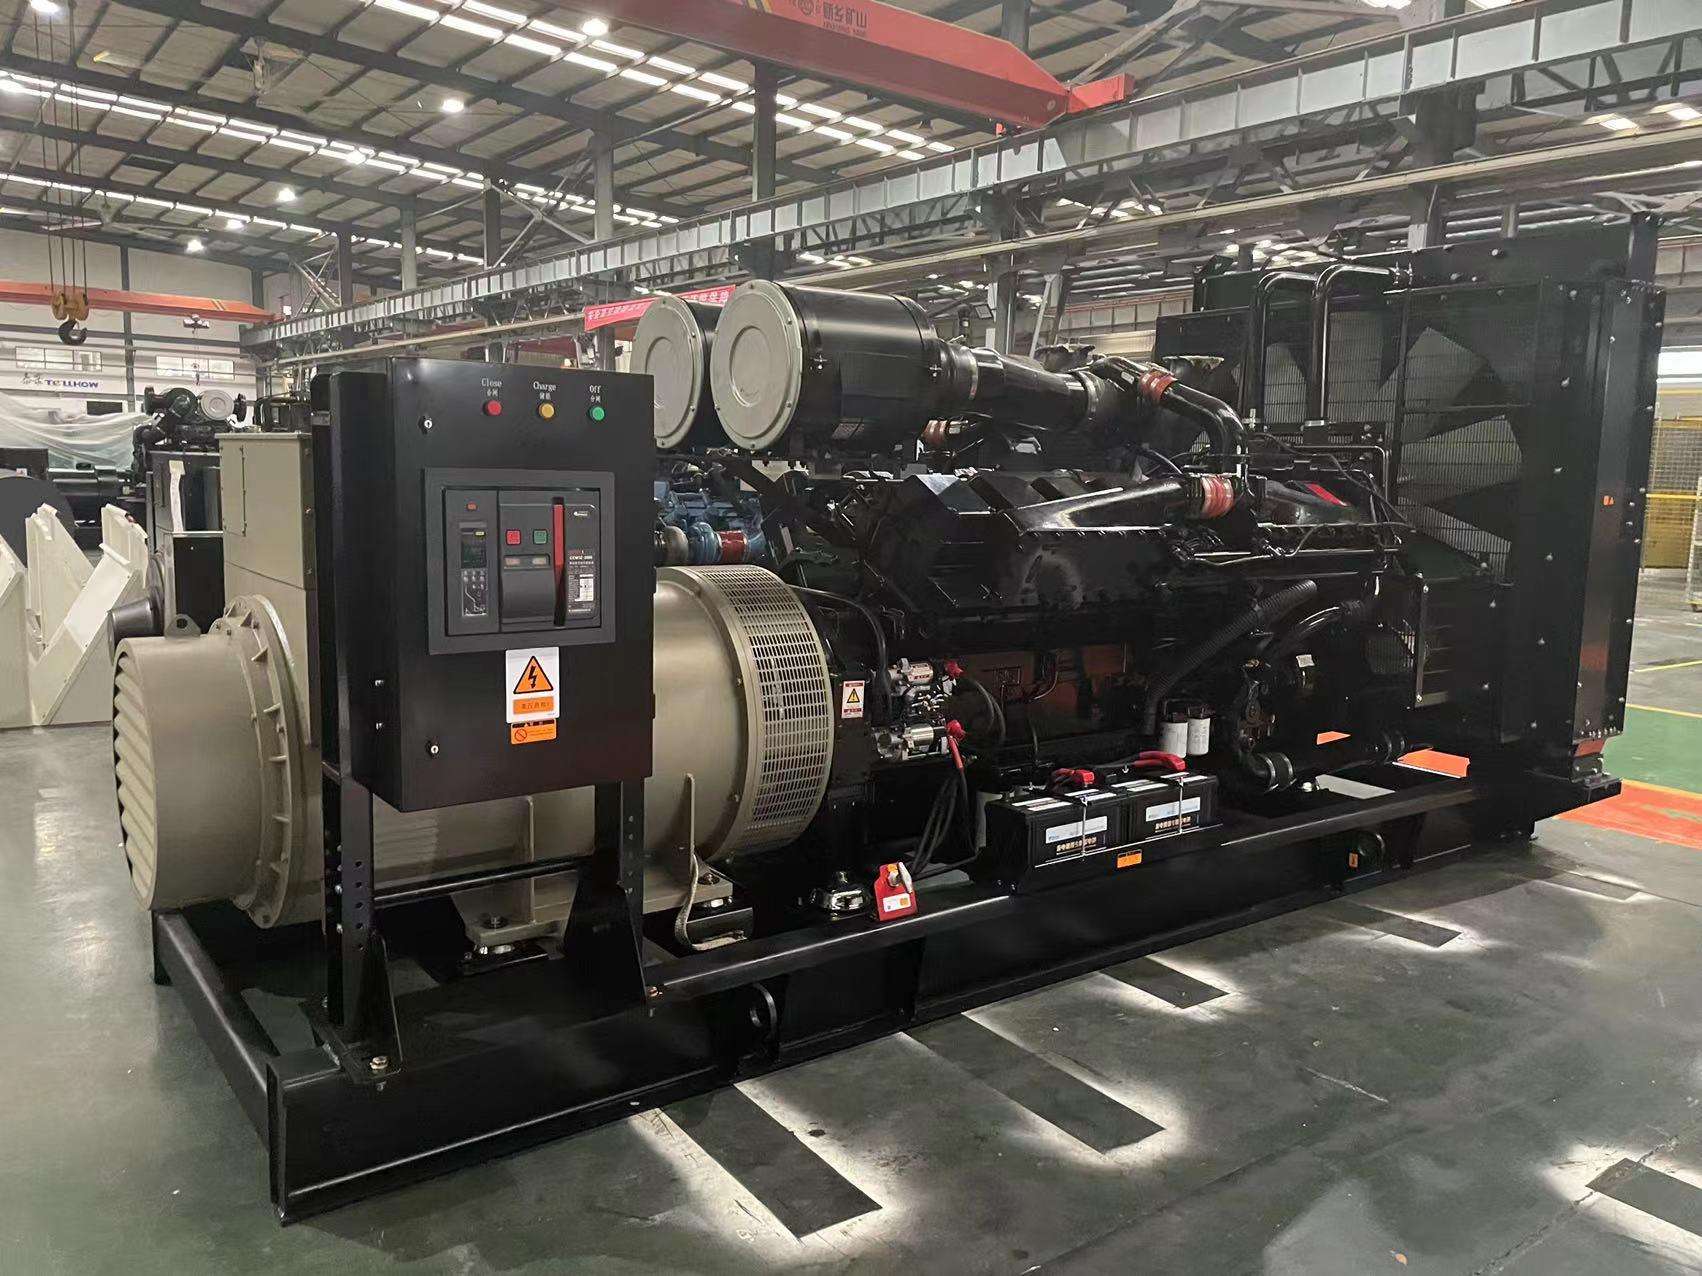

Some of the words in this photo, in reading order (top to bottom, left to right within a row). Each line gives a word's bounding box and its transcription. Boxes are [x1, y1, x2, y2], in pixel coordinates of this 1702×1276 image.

[481, 377, 502, 387] Close
[533, 381, 556, 392] Charge
[589, 385, 601, 394] Off
